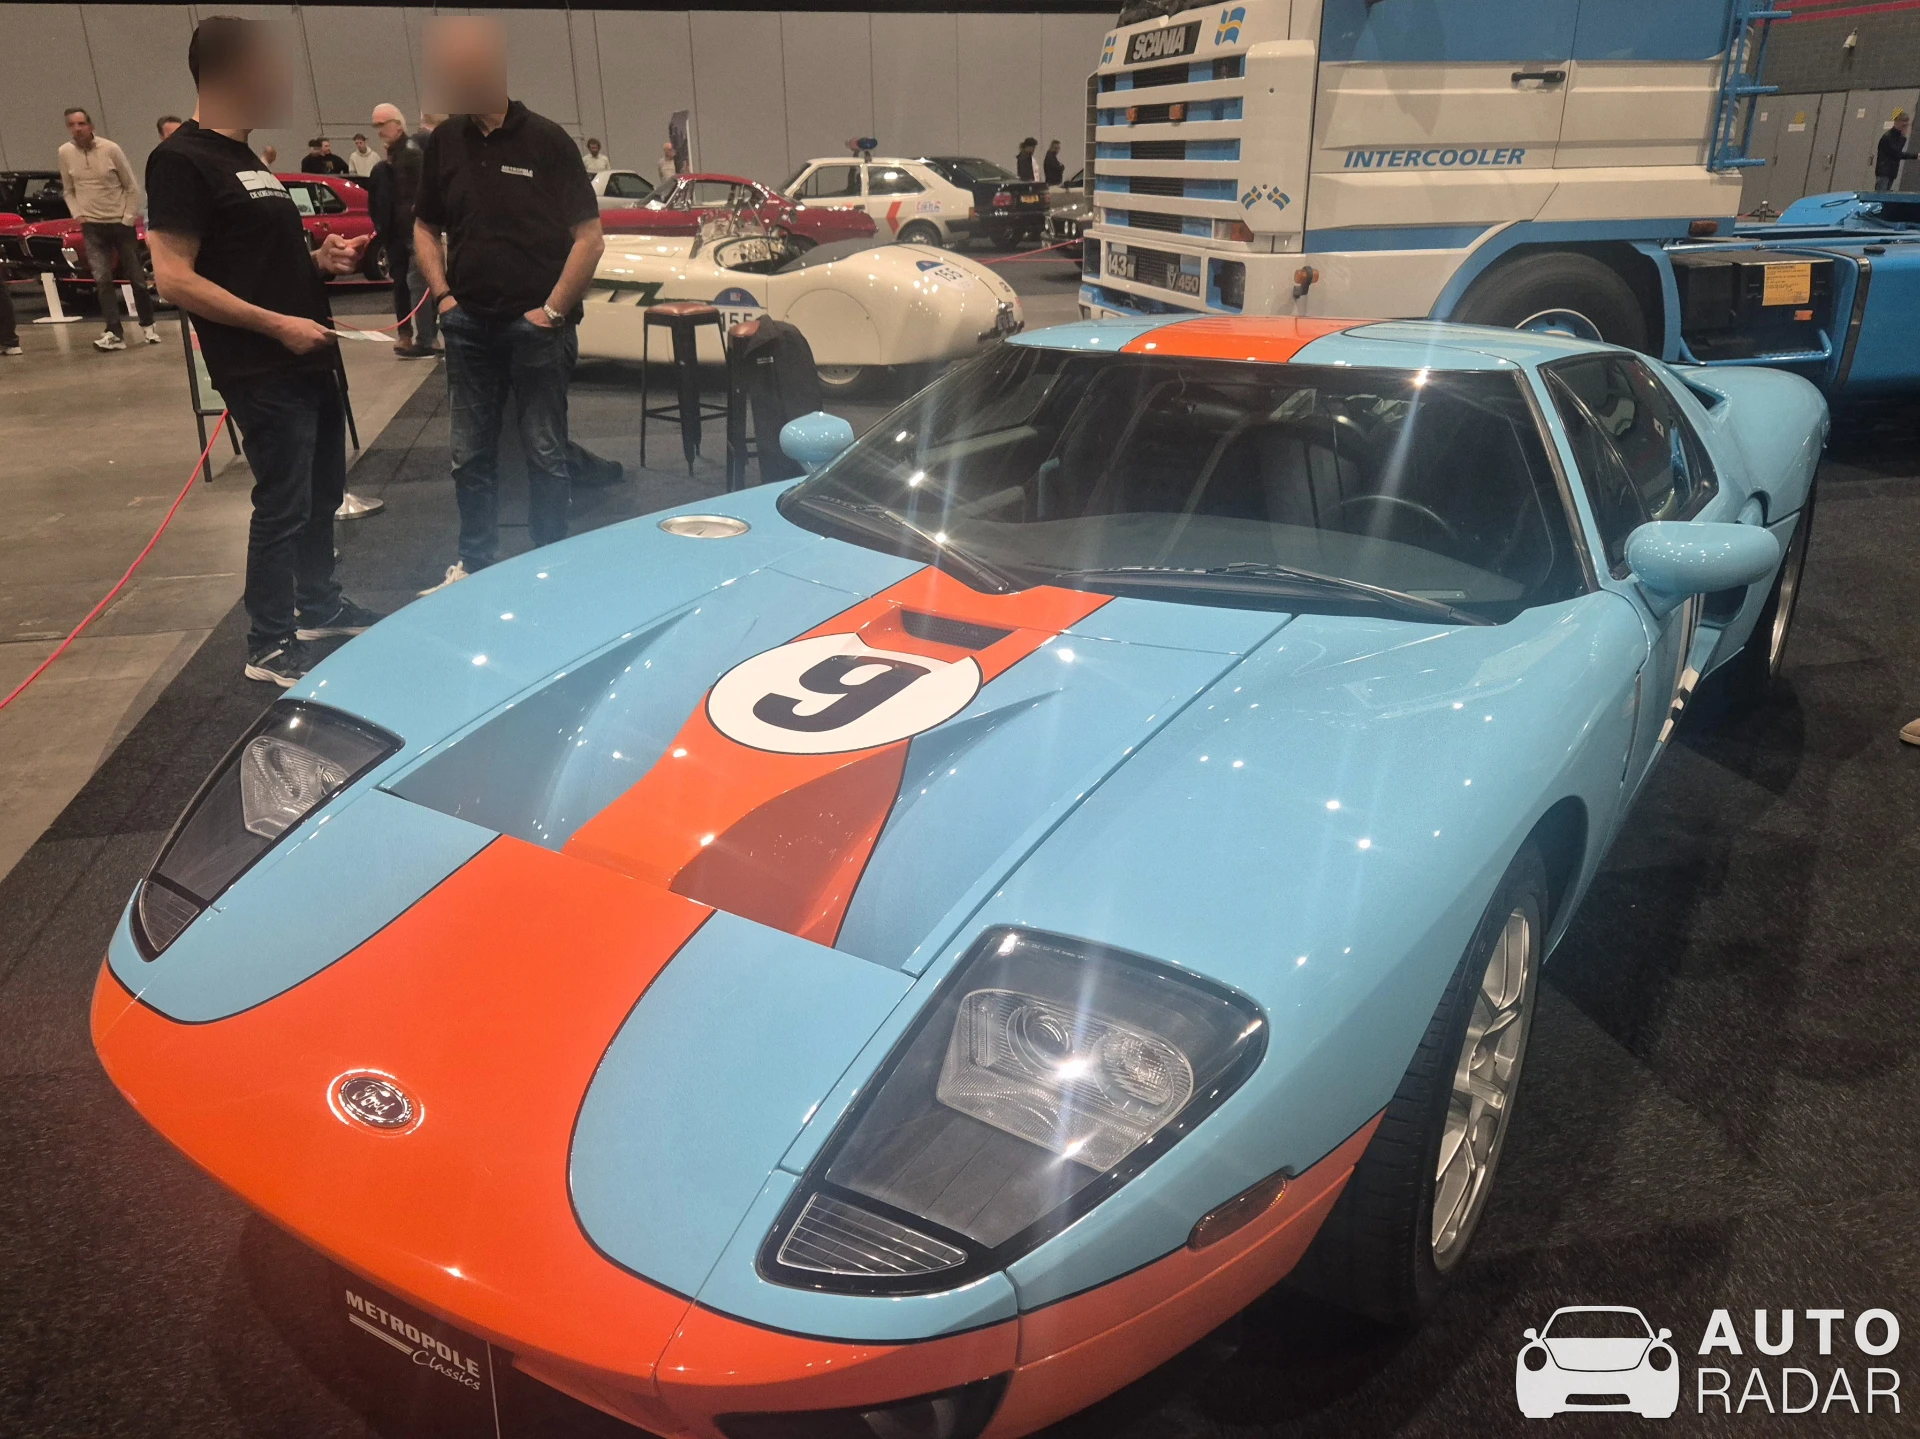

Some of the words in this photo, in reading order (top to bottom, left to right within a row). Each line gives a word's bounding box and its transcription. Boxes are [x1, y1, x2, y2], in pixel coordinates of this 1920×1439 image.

[1132, 25, 1187, 60] SCANIA
[1343, 147, 1526, 168] INTERCOOLER
[934, 267, 963, 282] 155
[1178, 274, 1199, 292] 450
[752, 655, 932, 733] 9
[351, 1084, 396, 1116] Ford
[345, 1289, 481, 1379] METROPOLE
[412, 1350, 481, 1391] Classics
